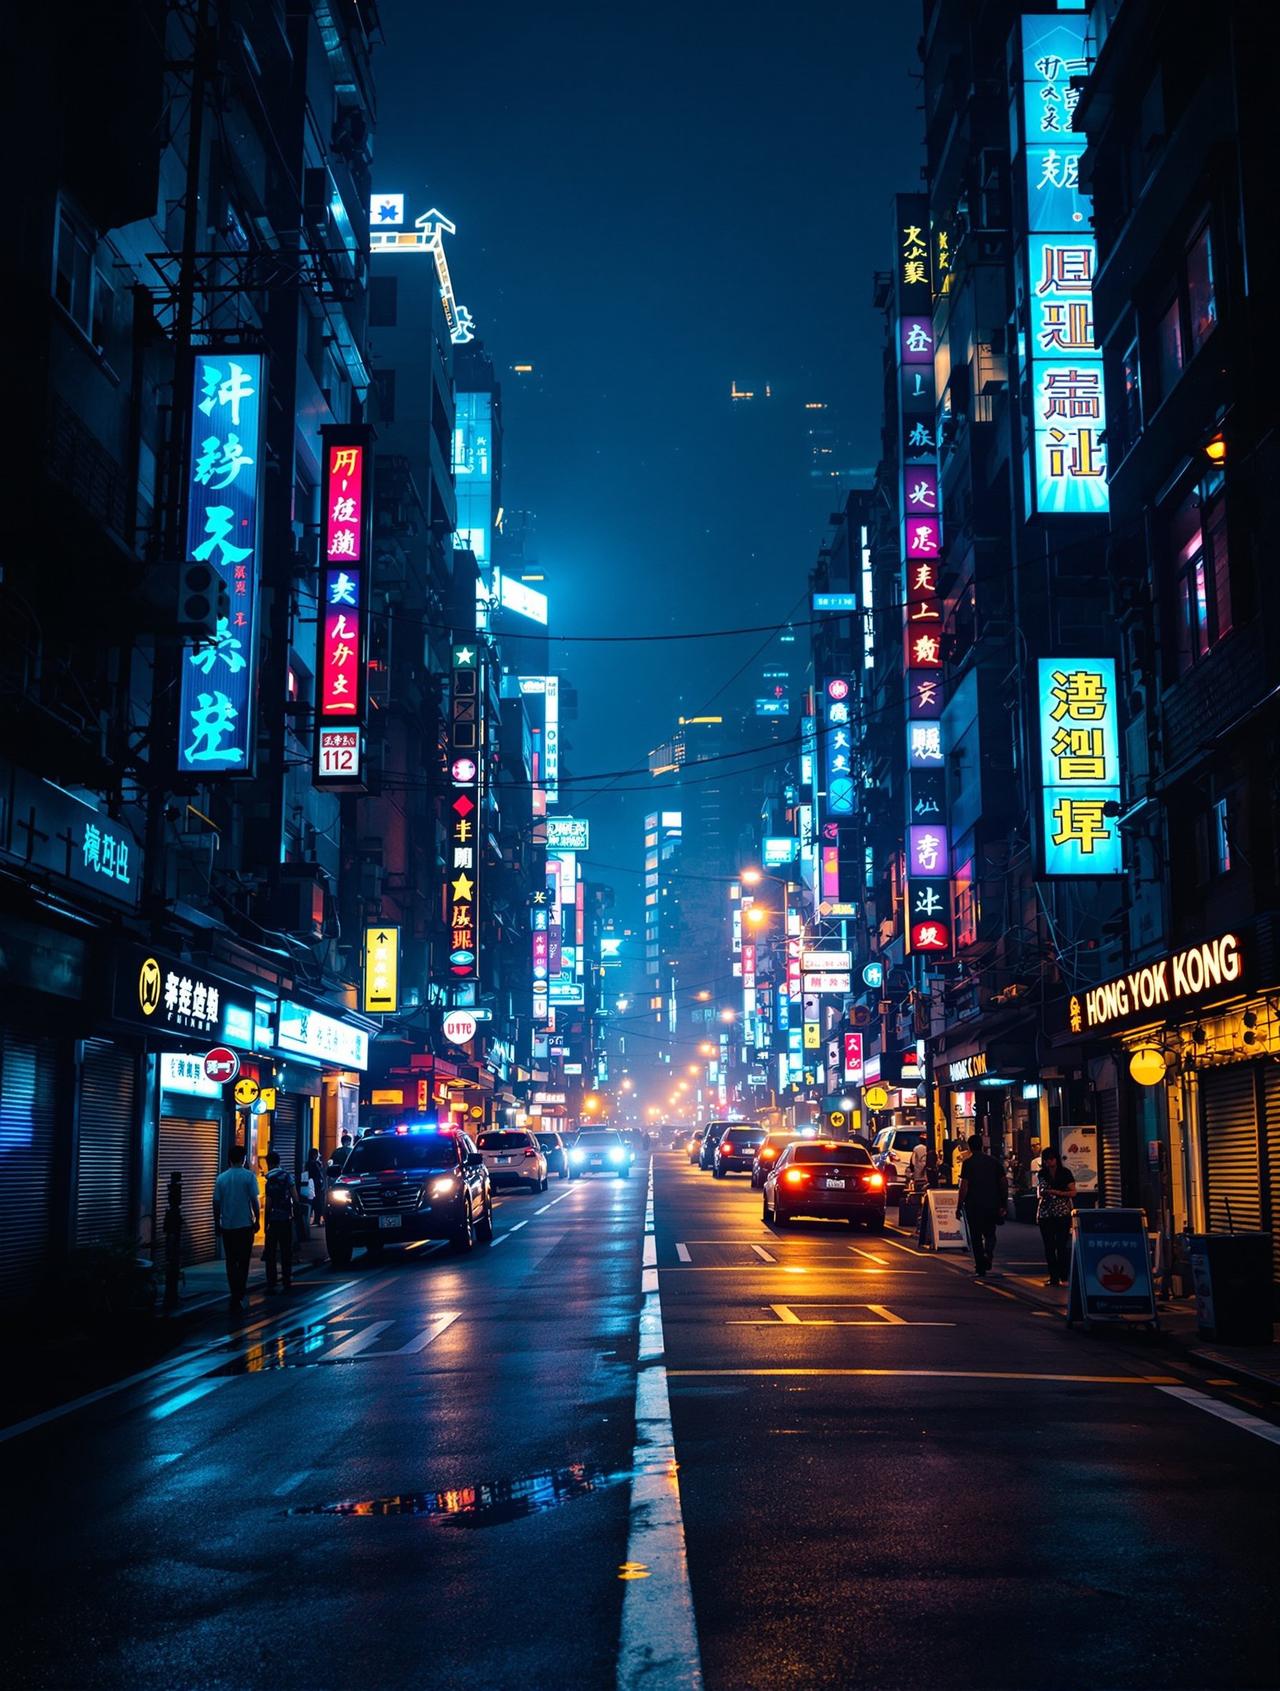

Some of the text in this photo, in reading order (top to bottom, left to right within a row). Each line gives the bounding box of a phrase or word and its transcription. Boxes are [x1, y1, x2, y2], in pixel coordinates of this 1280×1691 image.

[323, 750, 352, 770] 112
[1086, 979, 1129, 1026] HONG
[1128, 960, 1169, 1011] YOK
[1172, 934, 1239, 996] KONG
